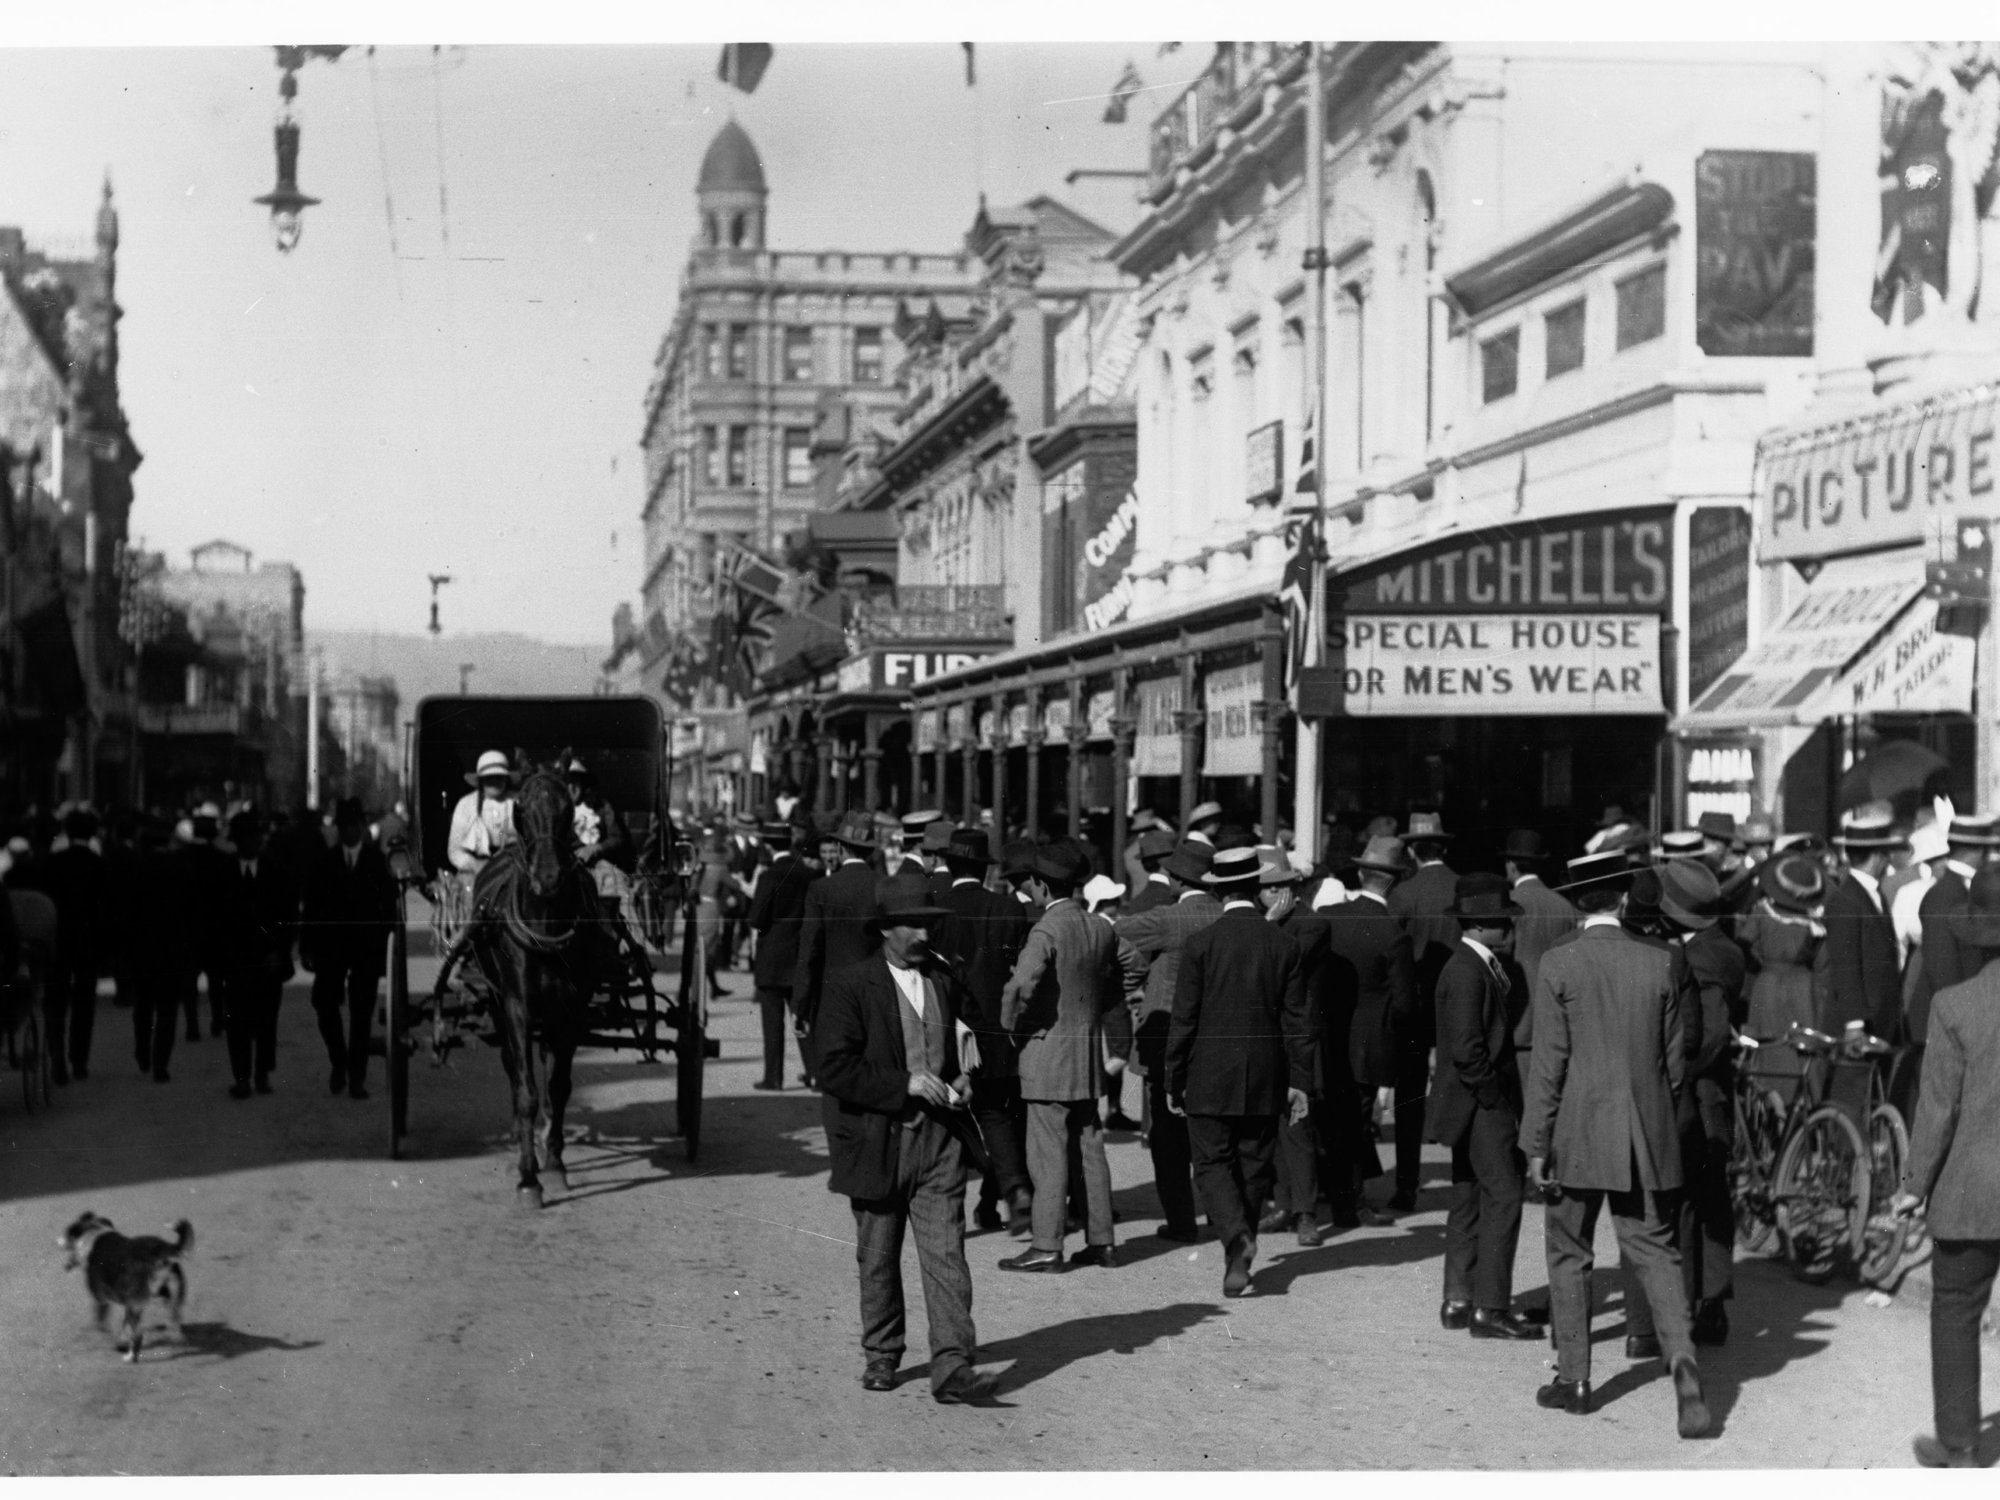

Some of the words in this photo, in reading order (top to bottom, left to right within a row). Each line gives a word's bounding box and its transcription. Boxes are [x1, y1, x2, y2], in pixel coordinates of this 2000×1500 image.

[1771, 427, 1995, 538] PICTURE
[1375, 520, 1667, 605] MITCHELL'S
[1326, 619, 1490, 650] SPECIAL
[1510, 619, 1642, 649] HOUSE
[1333, 666, 1387, 697] OR
[1403, 664, 1513, 696] MEN'S
